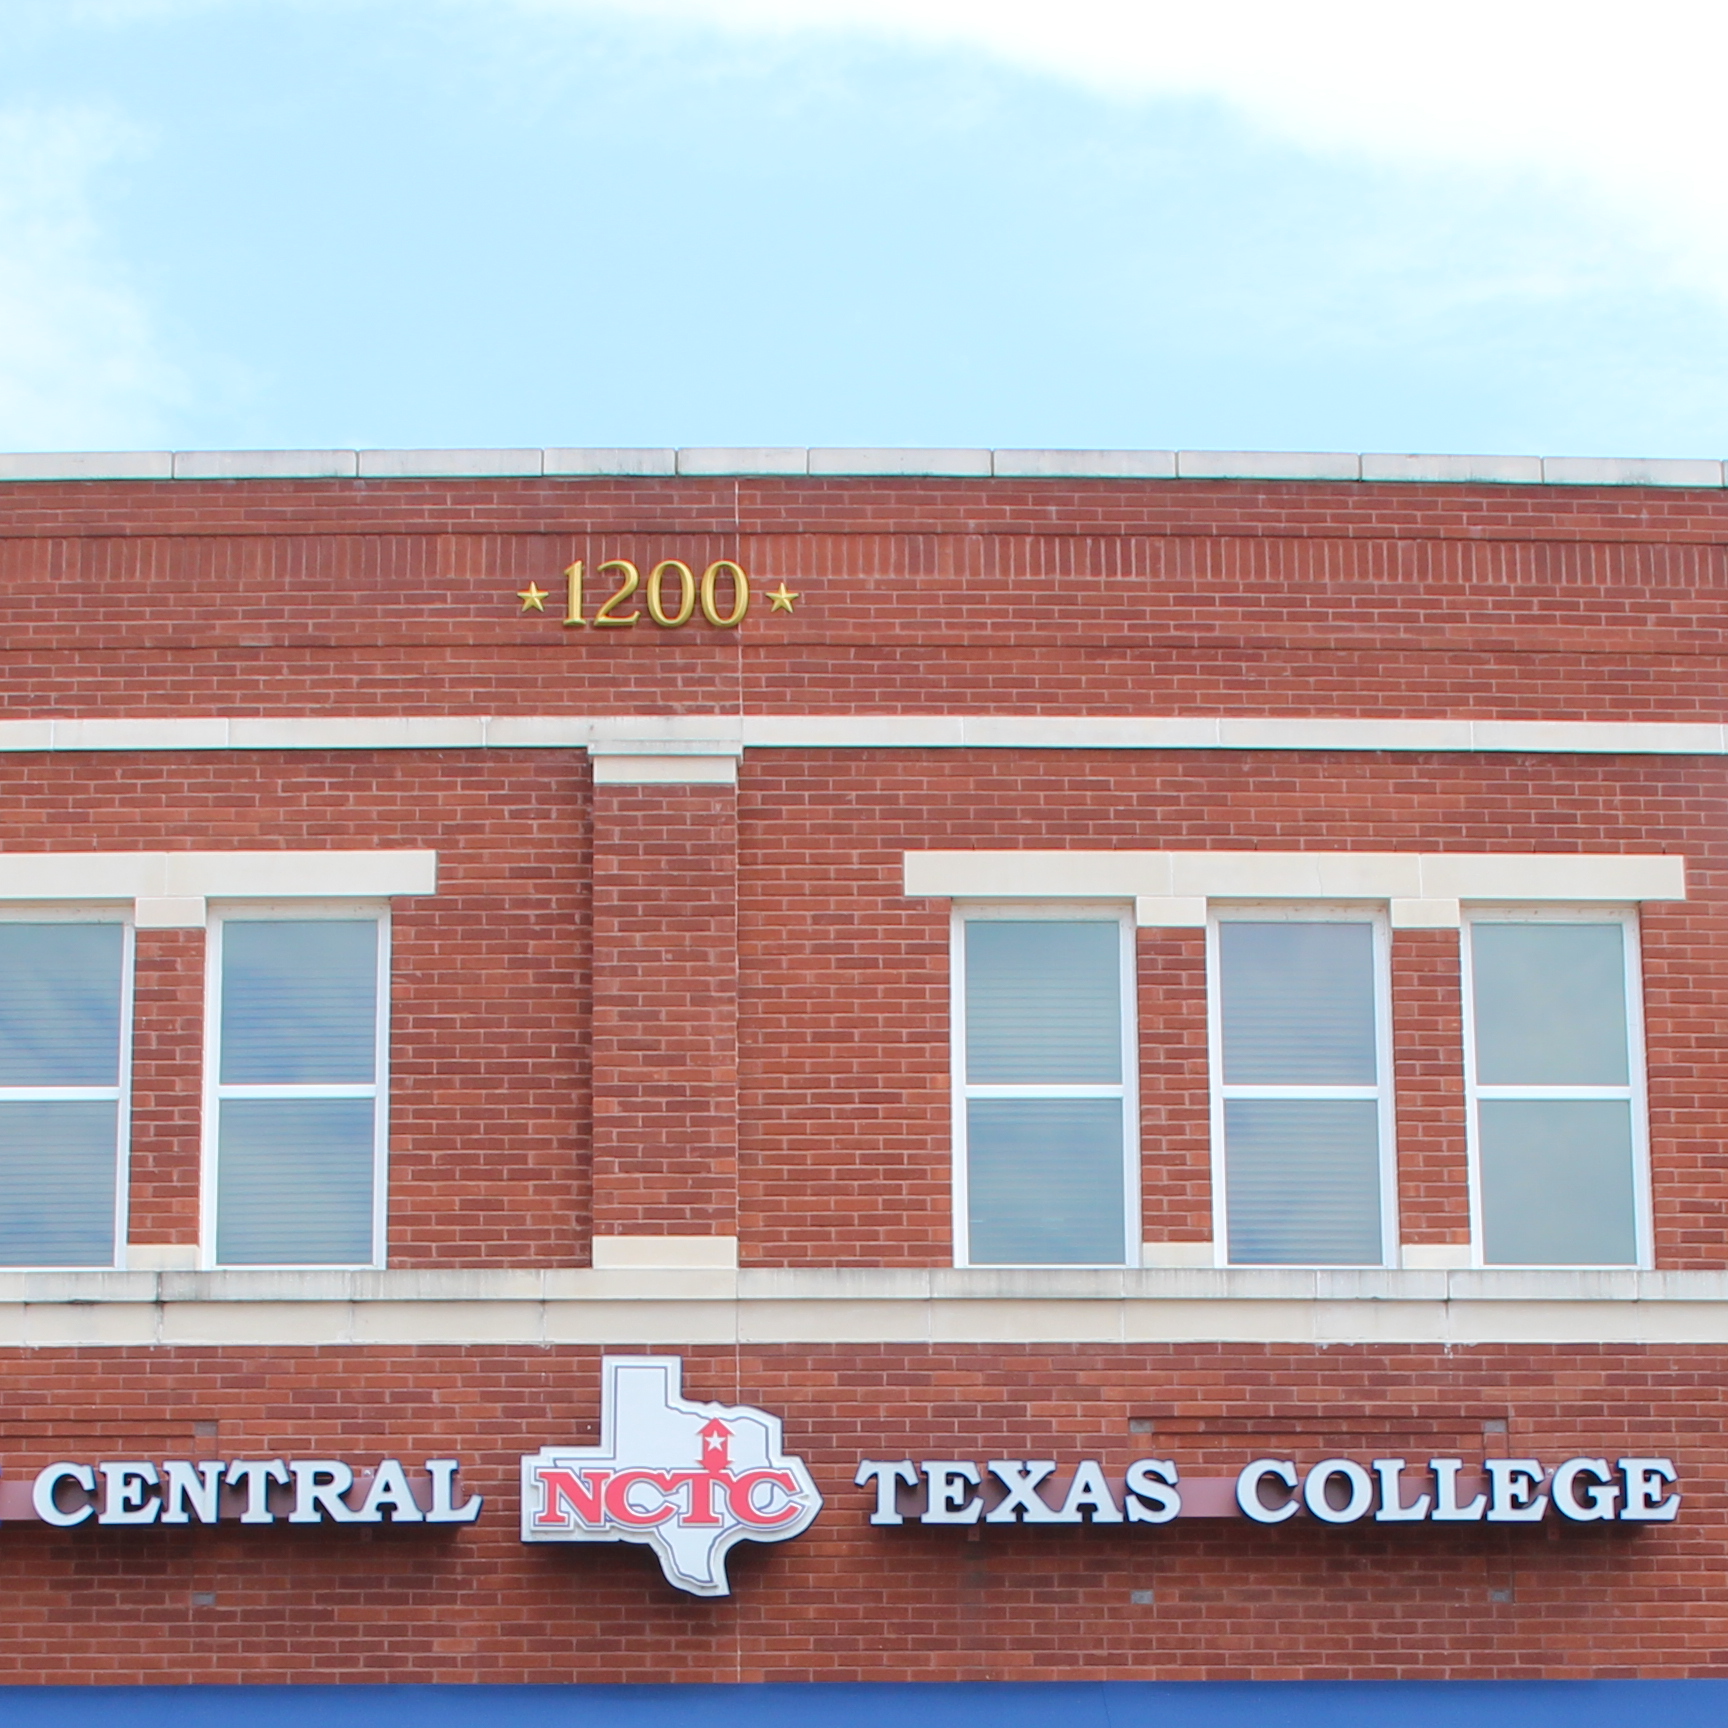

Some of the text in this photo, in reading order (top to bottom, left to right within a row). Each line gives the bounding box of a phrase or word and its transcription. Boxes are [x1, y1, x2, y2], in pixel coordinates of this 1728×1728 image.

[563, 559, 750, 628] 1200
[30, 1457, 484, 1528] CENTRAL
[532, 1466, 806, 1530] NCTC
[854, 1455, 1681, 1528] TEXAS COLLEGE
